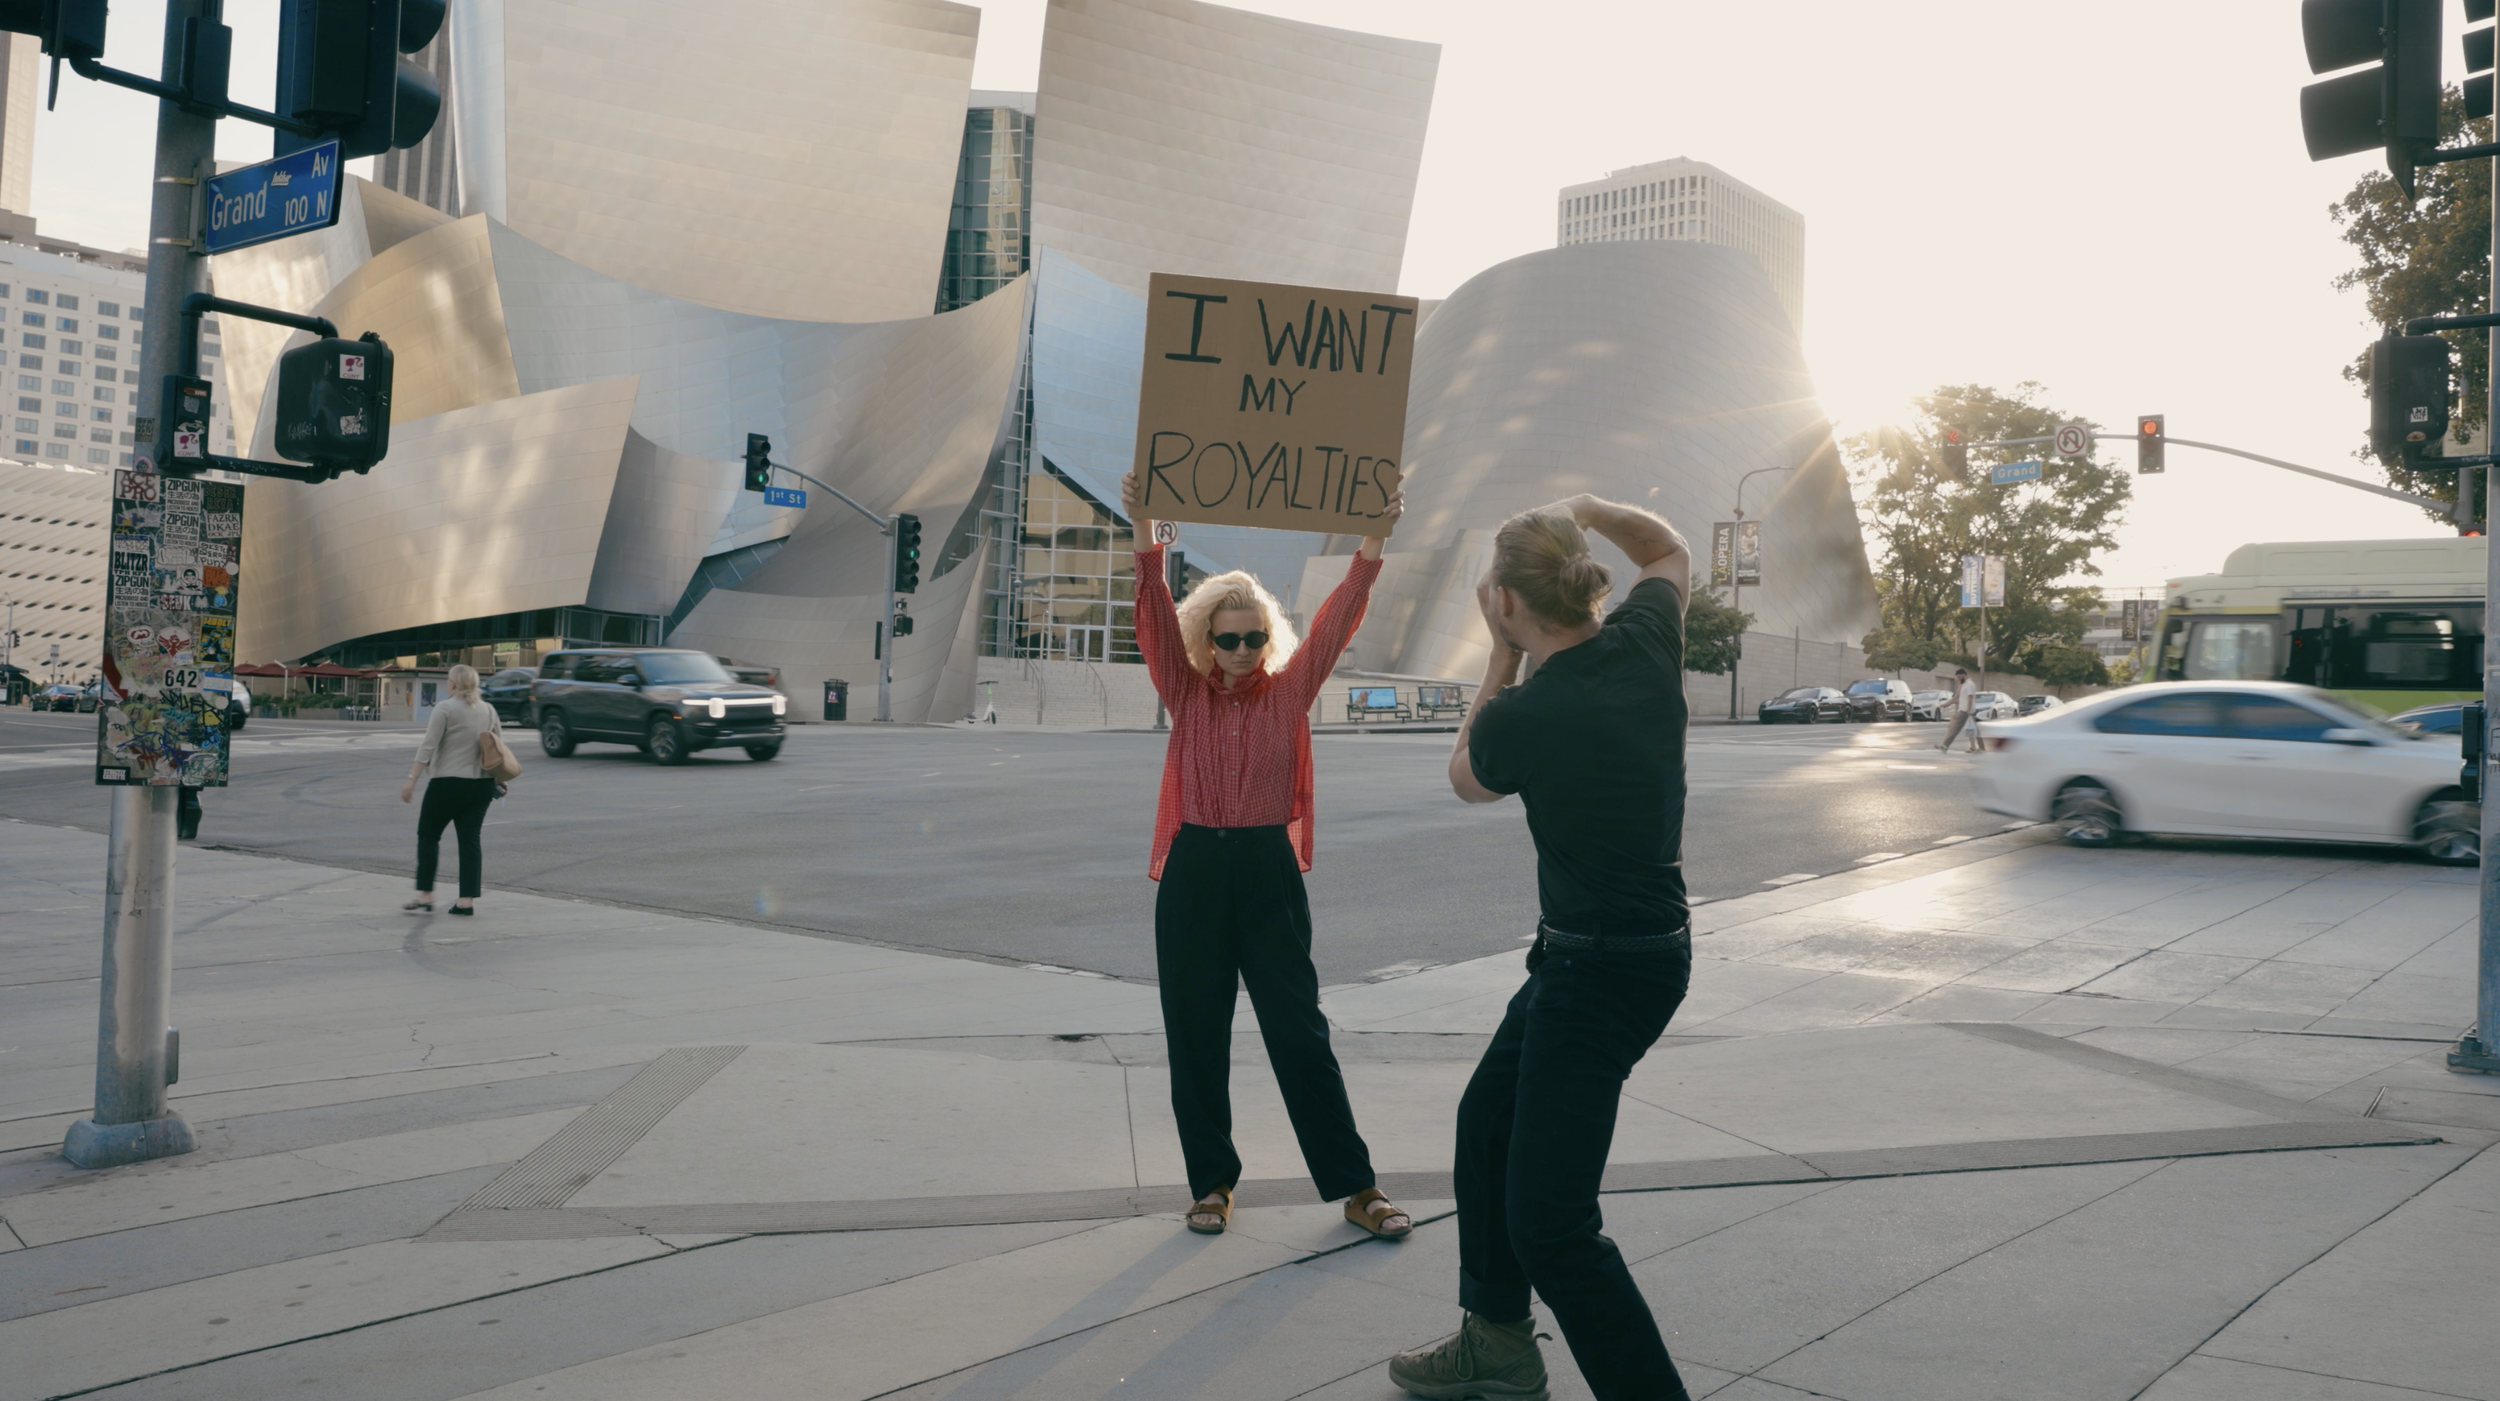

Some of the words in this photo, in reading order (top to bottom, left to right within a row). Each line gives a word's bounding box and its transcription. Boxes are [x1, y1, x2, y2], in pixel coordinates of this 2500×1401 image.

[212, 181, 267, 230] Grand
[311, 152, 329, 178] Av
[285, 195, 308, 226] 100
[316, 190, 327, 217] N
[1165, 291, 1227, 364] I
[1257, 299, 1414, 375] WANT
[1239, 374, 1306, 416] MY
[1144, 432, 1396, 519] ROYALTIES
[1998, 464, 2036, 479] Grand
[120, 485, 156, 500] PRO
[168, 480, 200, 492] ZIPGUN
[770, 491, 784, 502] 1st
[789, 493, 801, 504] St
[167, 513, 199, 527] ZIPGUN
[114, 551, 148, 571] BLITZR
[115, 575, 149, 587] ZIPGUN
[165, 669, 197, 687] 642
